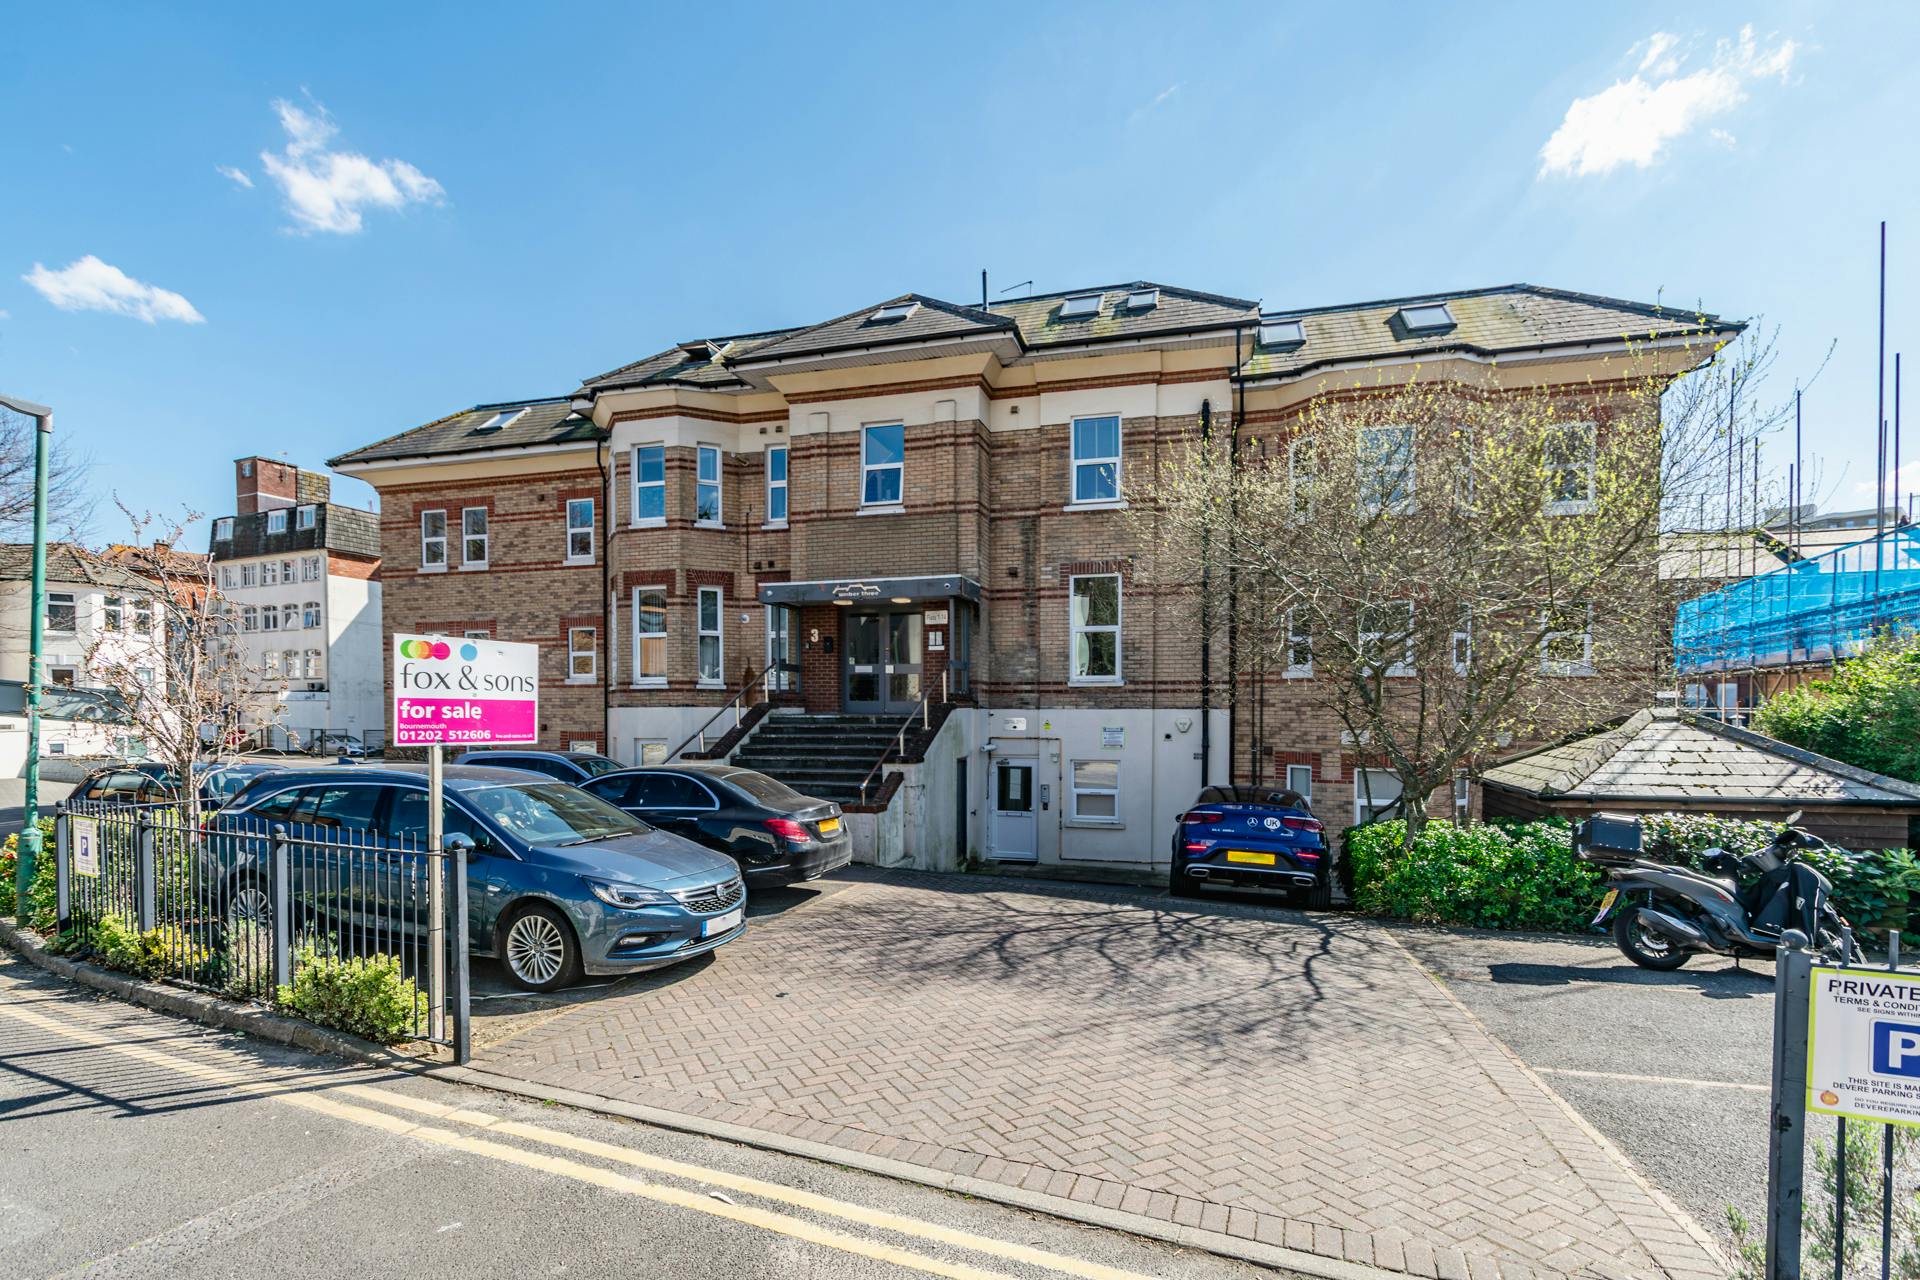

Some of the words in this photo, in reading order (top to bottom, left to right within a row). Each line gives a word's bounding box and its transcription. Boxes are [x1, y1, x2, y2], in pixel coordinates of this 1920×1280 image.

[810, 628, 819, 642] 3
[400, 662, 451, 689] fox
[458, 665, 478, 691] &
[483, 674, 535, 692] sons
[400, 700, 436, 719] for
[441, 702, 482, 719] sale
[400, 730, 444, 740] 01202
[448, 730, 492, 740] 512606
[1266, 819, 1278, 828] UK
[1828, 979, 1920, 1001] PRIVATE
[1833, 995, 1870, 1006] TERMS
[1873, 1008, 1896, 1016] SIGNS
[1889, 1030, 1920, 1069] P
[1848, 1076, 1868, 1086] THIS
[1870, 1079, 1891, 1089] SITE
[1893, 1082, 1902, 1090] IS
[1832, 1082, 1871, 1093] DEVERE
[1872, 1087, 1913, 1099] PARKING
